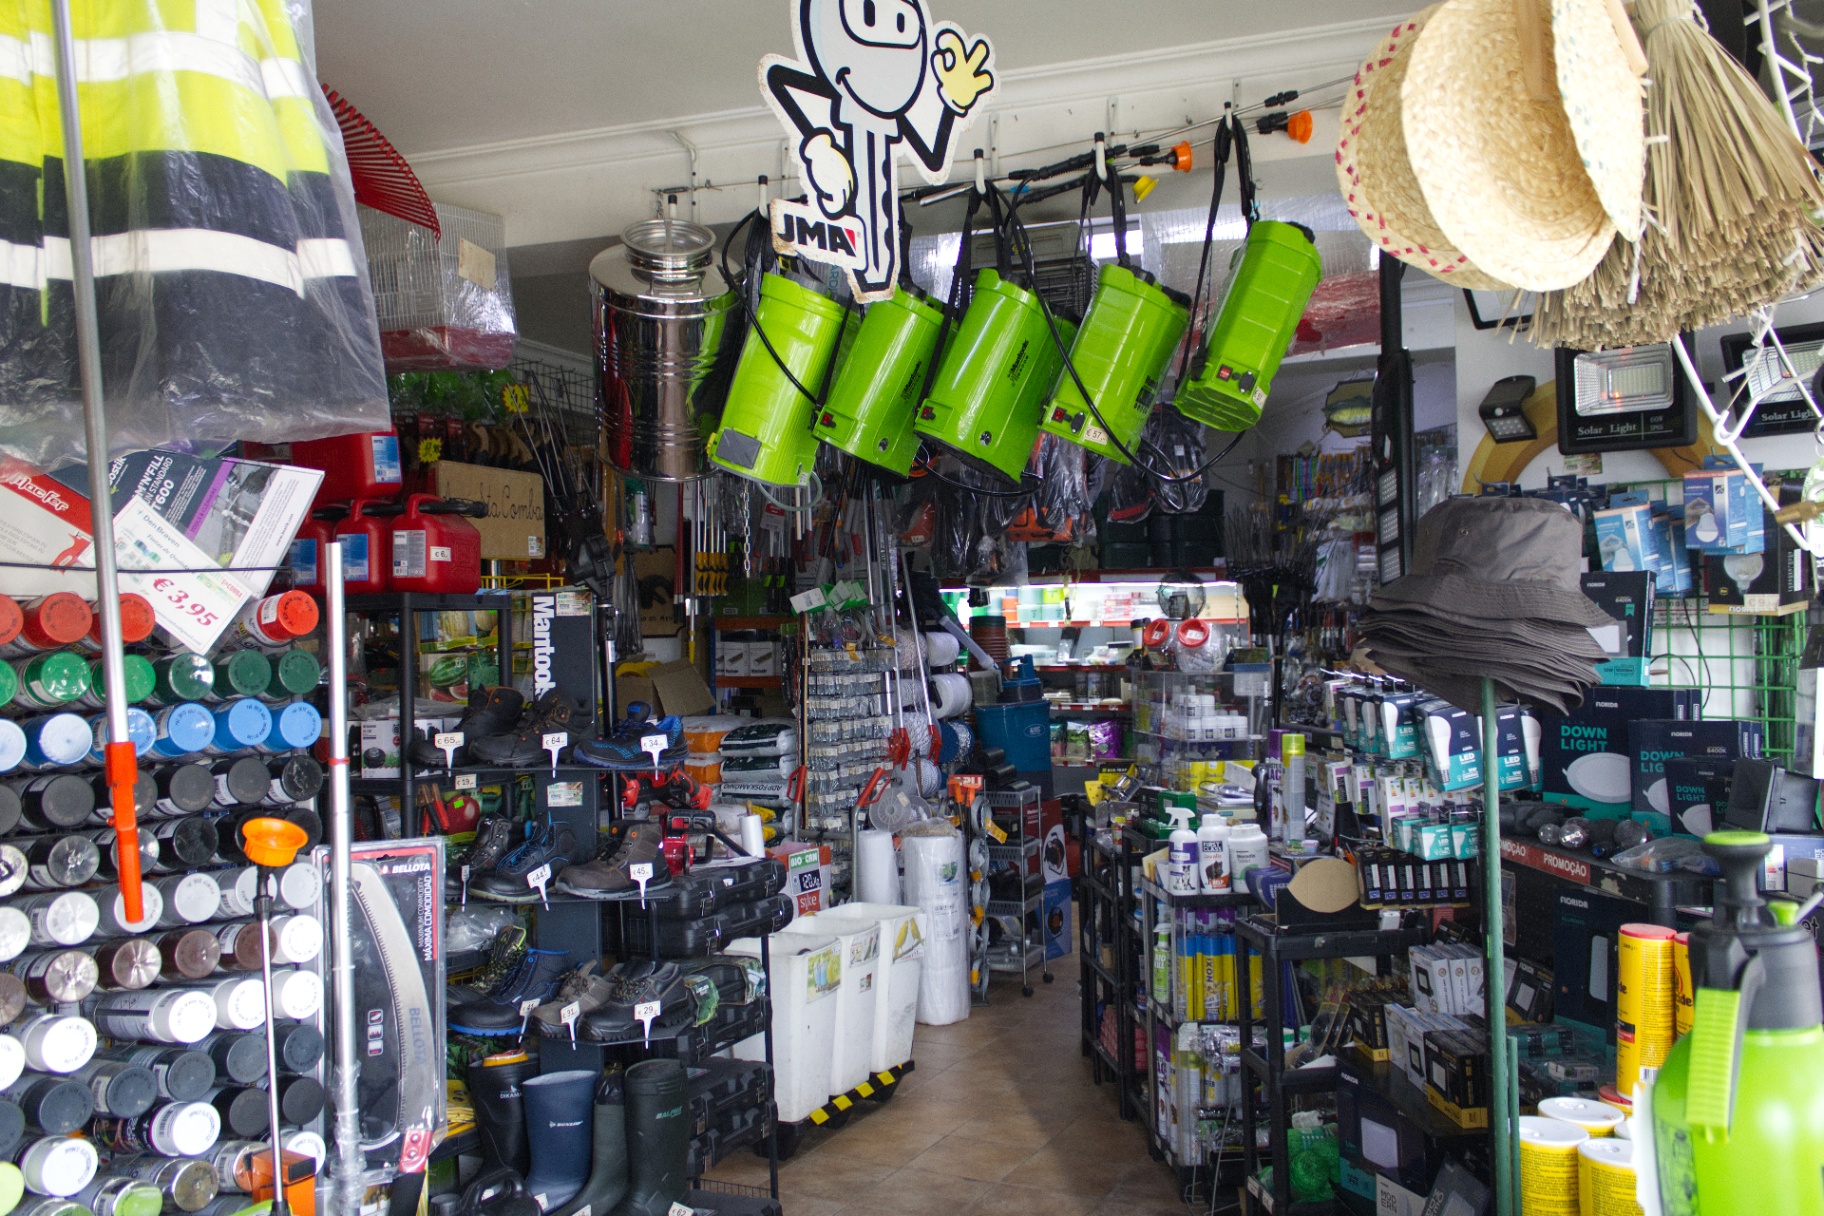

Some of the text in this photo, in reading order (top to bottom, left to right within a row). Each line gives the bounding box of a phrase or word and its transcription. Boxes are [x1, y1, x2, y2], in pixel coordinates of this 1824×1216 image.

[777, 213, 857, 257] JMA
[1762, 409, 1814, 422] Solar Ligh
[1578, 422, 1637, 436] Solar Light
[154, 521, 181, 549] Braven
[152, 577, 219, 627] € 3,95
[1561, 725, 1608, 739] DOWN
[1561, 738, 1608, 752] LIGHT
[1459, 753, 1475, 761] LED
[1504, 756, 1520, 764] LED
[1676, 785, 1705, 794] DOWN
[1676, 794, 1706, 802] LIGHT
[391, 863, 431, 874] BELLOTA
[1543, 853, 1587, 877] PROMOÇÃO
[800, 894, 818, 908] spike
[422, 875, 433, 962] MÁXIMA COMODIDAD
